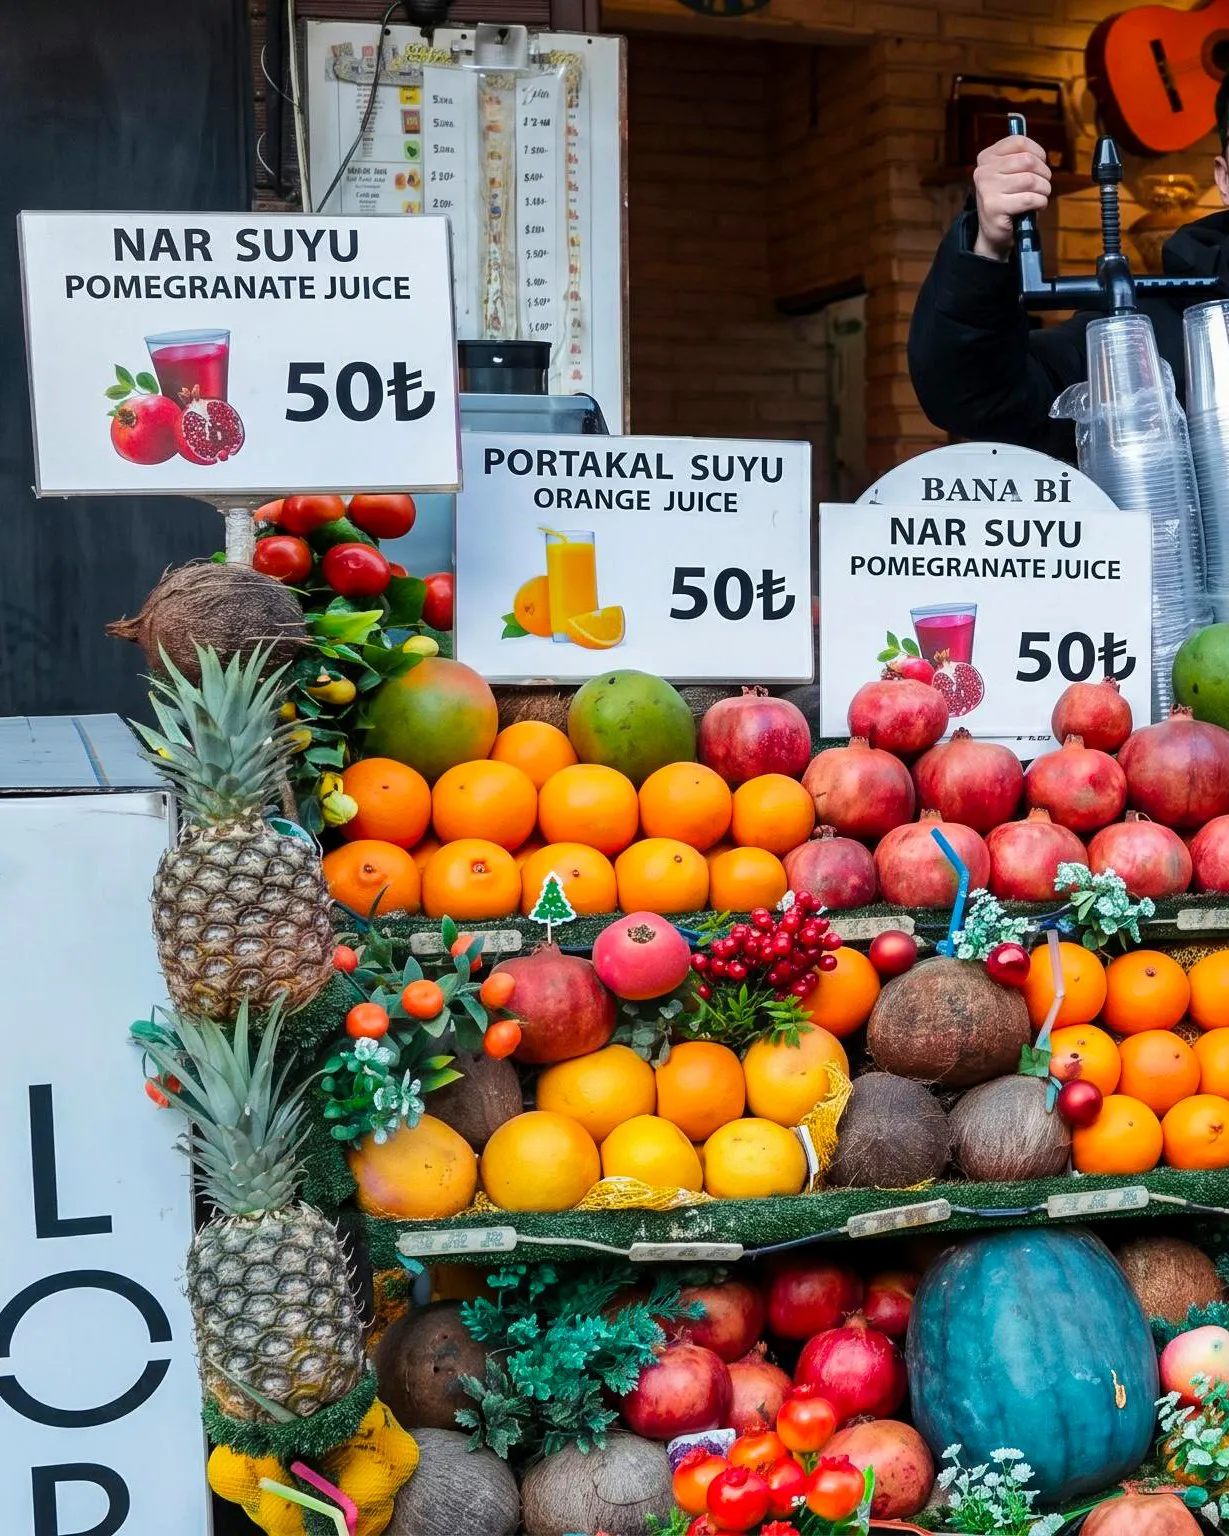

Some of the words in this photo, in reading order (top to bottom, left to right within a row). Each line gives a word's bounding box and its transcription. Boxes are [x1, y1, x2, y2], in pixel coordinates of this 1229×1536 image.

[114, 229, 212, 261] NAR
[236, 229, 358, 262] SUYU
[66, 276, 315, 299] POMEGRANATE
[325, 277, 410, 299] JUICE
[286, 362, 435, 422] 50₺
[485, 448, 673, 479] PORTAKAL
[692, 455, 782, 483] SUYU
[534, 488, 650, 510] ORANGE
[664, 491, 737, 512] JUICE
[922, 478, 1022, 501] BANA
[891, 518, 966, 545] NAR
[985, 520, 1081, 548] SUYU
[851, 556, 1045, 578] POMEGRANATE
[1052, 560, 1120, 579] JUICE
[670, 567, 795, 620] 50₺
[1016, 632, 1136, 682] 50₺
